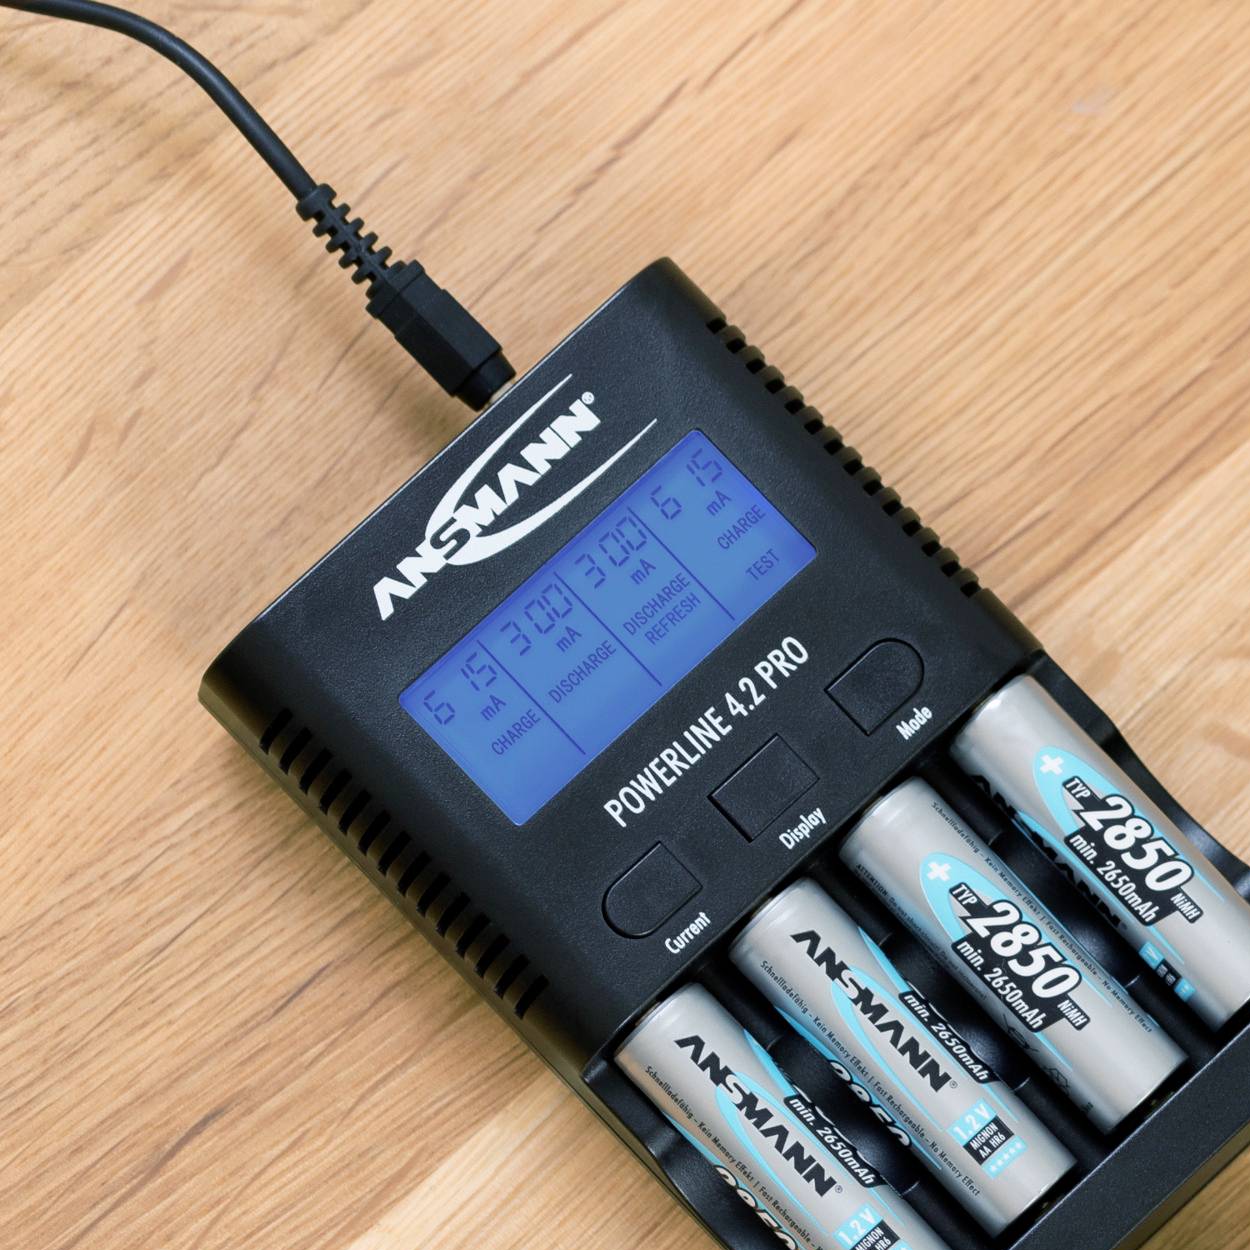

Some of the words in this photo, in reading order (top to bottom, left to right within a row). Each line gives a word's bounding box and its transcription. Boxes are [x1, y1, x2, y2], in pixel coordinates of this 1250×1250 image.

[701, 486, 733, 517] mA
[714, 502, 767, 551] CHARGE
[625, 554, 657, 586] mA
[744, 547, 782, 583] TEST
[620, 570, 692, 636] DISCHARGE
[643, 590, 703, 646] REFRESH
[551, 621, 583, 653] mA
[546, 638, 618, 704] DISCHARGE
[475, 690, 508, 722] mA
[894, 701, 935, 741] Mode
[488, 707, 542, 757] CHARGE
[603, 706, 733, 828] POWERLINE
[724, 677, 766, 717] 4.2
[753, 636, 809, 690] PRO
[776, 803, 829, 853] Display
[1065, 777, 1091, 798] TYP
[1079, 782, 1196, 891] 2850
[1170, 892, 1201, 920] NiMH
[1069, 834, 1098, 865] min.
[1096, 860, 1160, 922] 2650mAh
[662, 909, 713, 956] Current
[952, 881, 978, 905] TYP
[966, 887, 1085, 998] 2850
[1057, 999, 1088, 1027] NiMH
[956, 941, 985, 971] min.
[983, 967, 1047, 1029] 2650mAh
[903, 994, 930, 1022] min.
[930, 1022, 989, 1081] 2650mAh
[811, 1015, 829, 1034] Kein
[824, 1029, 853, 1060] Memory
[848, 1055, 870, 1078] Effekt
[871, 1080, 889, 1098] Fast
[883, 1093, 927, 1140] Rechargeable
[927, 1140, 941, 1154] No
[935, 1150, 965, 1180] Memory
[959, 1174, 982, 1197] Effect
[951, 1112, 982, 1142] 1.2
[973, 1102, 993, 1122] V
[789, 1098, 816, 1126] min.
[815, 1126, 875, 1184] 2650mAh
[968, 1121, 999, 1151] MIGNON
[976, 1143, 992, 1159] AA
[987, 1130, 1007, 1149] HR6
[696, 1120, 715, 1140] Kein
[709, 1135, 738, 1165] Memory
[733, 1159, 756, 1182] Effekt
[757, 1185, 775, 1203] Fast
[769, 1198, 813, 1244] Rechargeable
[836, 1217, 867, 1247] 1.2
[858, 1207, 879, 1228] V
